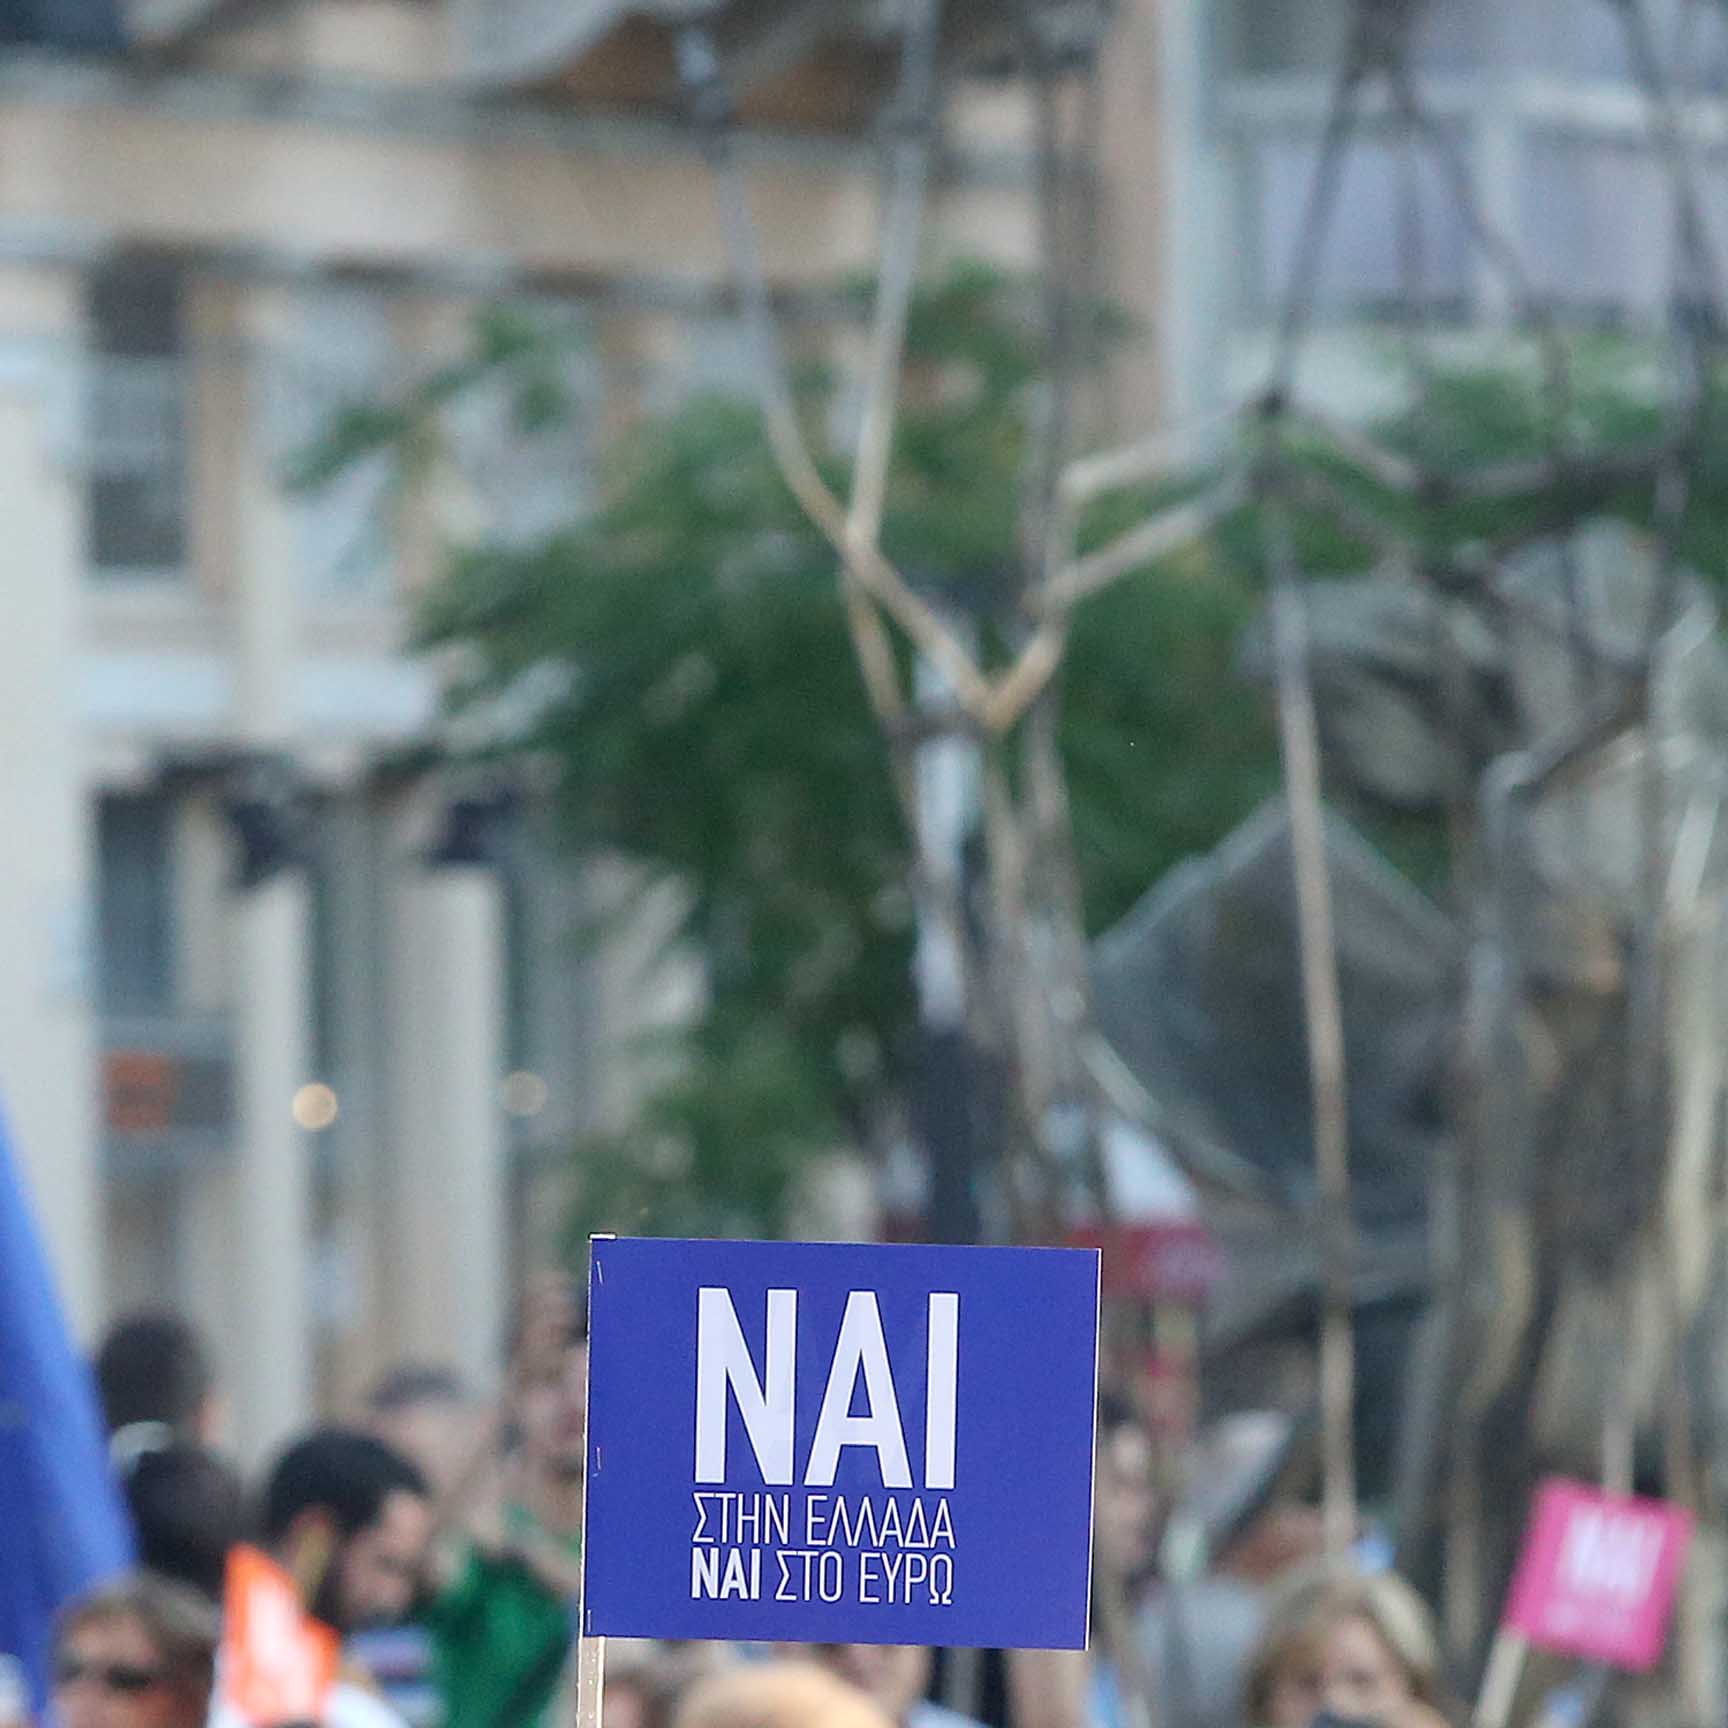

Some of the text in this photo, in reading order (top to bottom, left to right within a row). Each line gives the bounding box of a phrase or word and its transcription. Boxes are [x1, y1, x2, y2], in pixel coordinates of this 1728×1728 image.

[695, 1287, 959, 1489] ΝΑΙ
[691, 1492, 956, 1549] ΣΤΗΝ ΕΛΛΑΔΑ
[690, 1548, 953, 1605] ΝΑΙ ΣΤΟ ΕΥΡΩ
